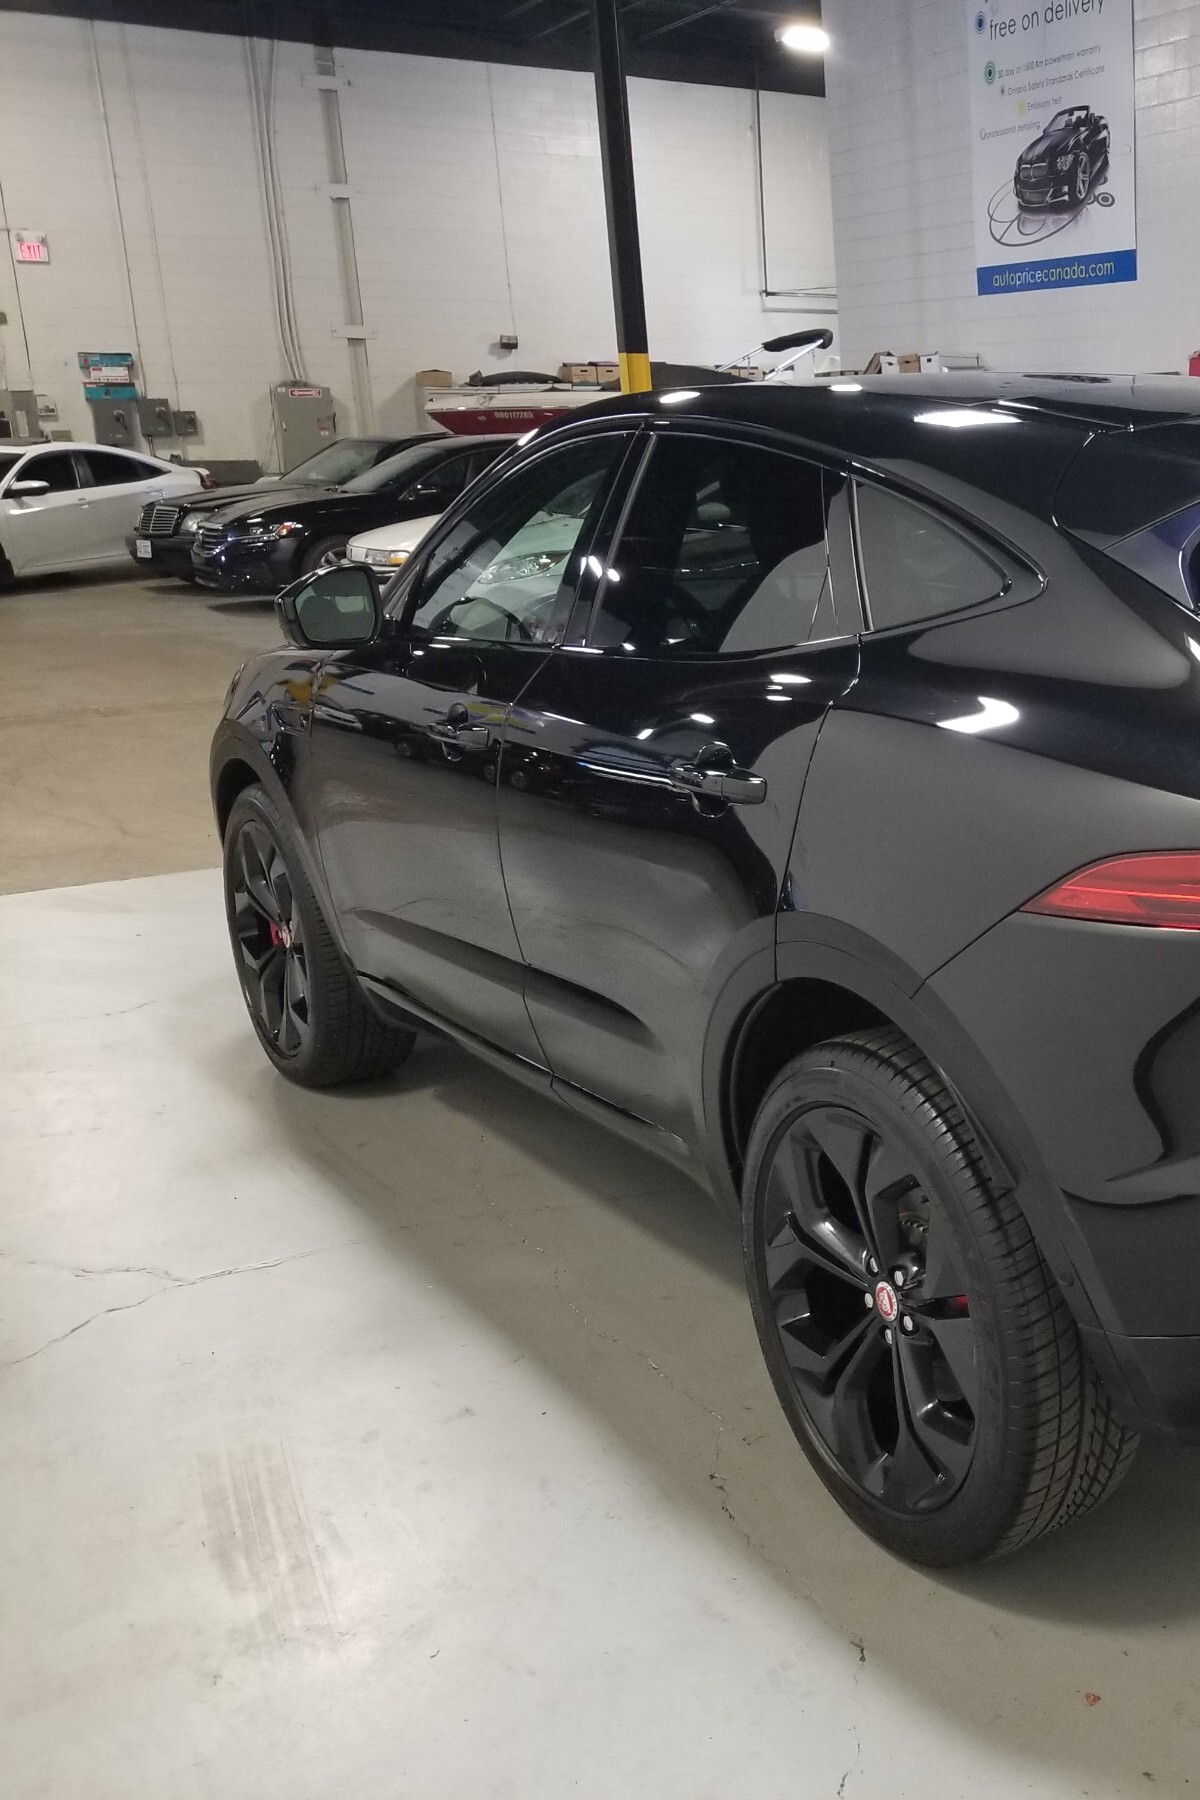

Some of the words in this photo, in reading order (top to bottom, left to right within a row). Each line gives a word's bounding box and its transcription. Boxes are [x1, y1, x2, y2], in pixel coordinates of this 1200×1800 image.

[990, 18, 1016, 40] free
[1022, 11, 1039, 30] on
[1044, 0, 1103, 23] delivery
[20, 243, 41, 259] EXIT
[993, 261, 1114, 288] autopricecanada.com
